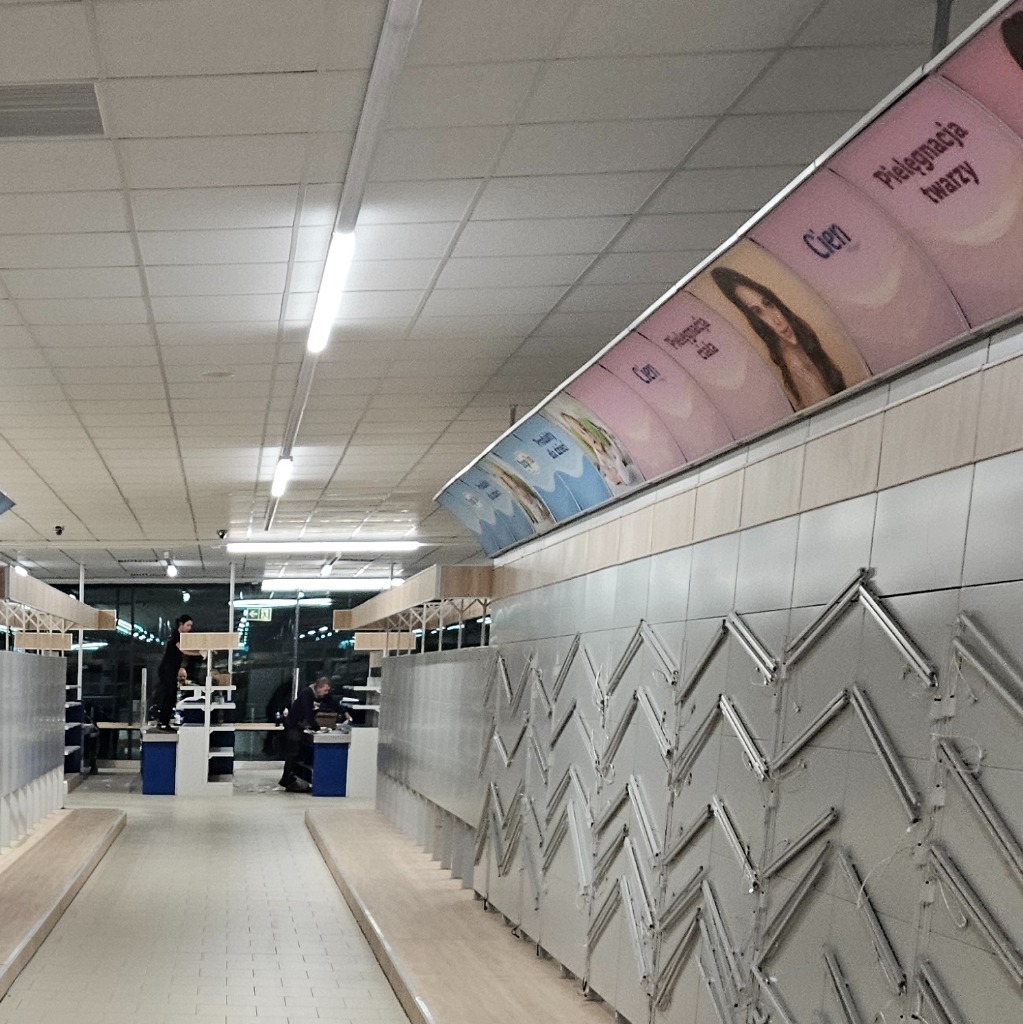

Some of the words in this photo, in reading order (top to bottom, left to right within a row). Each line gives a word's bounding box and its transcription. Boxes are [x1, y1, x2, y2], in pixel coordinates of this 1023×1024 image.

[872, 121, 969, 190] Pielęgnacja
[919, 160, 980, 204] twarzy
[802, 223, 852, 260] Cien
